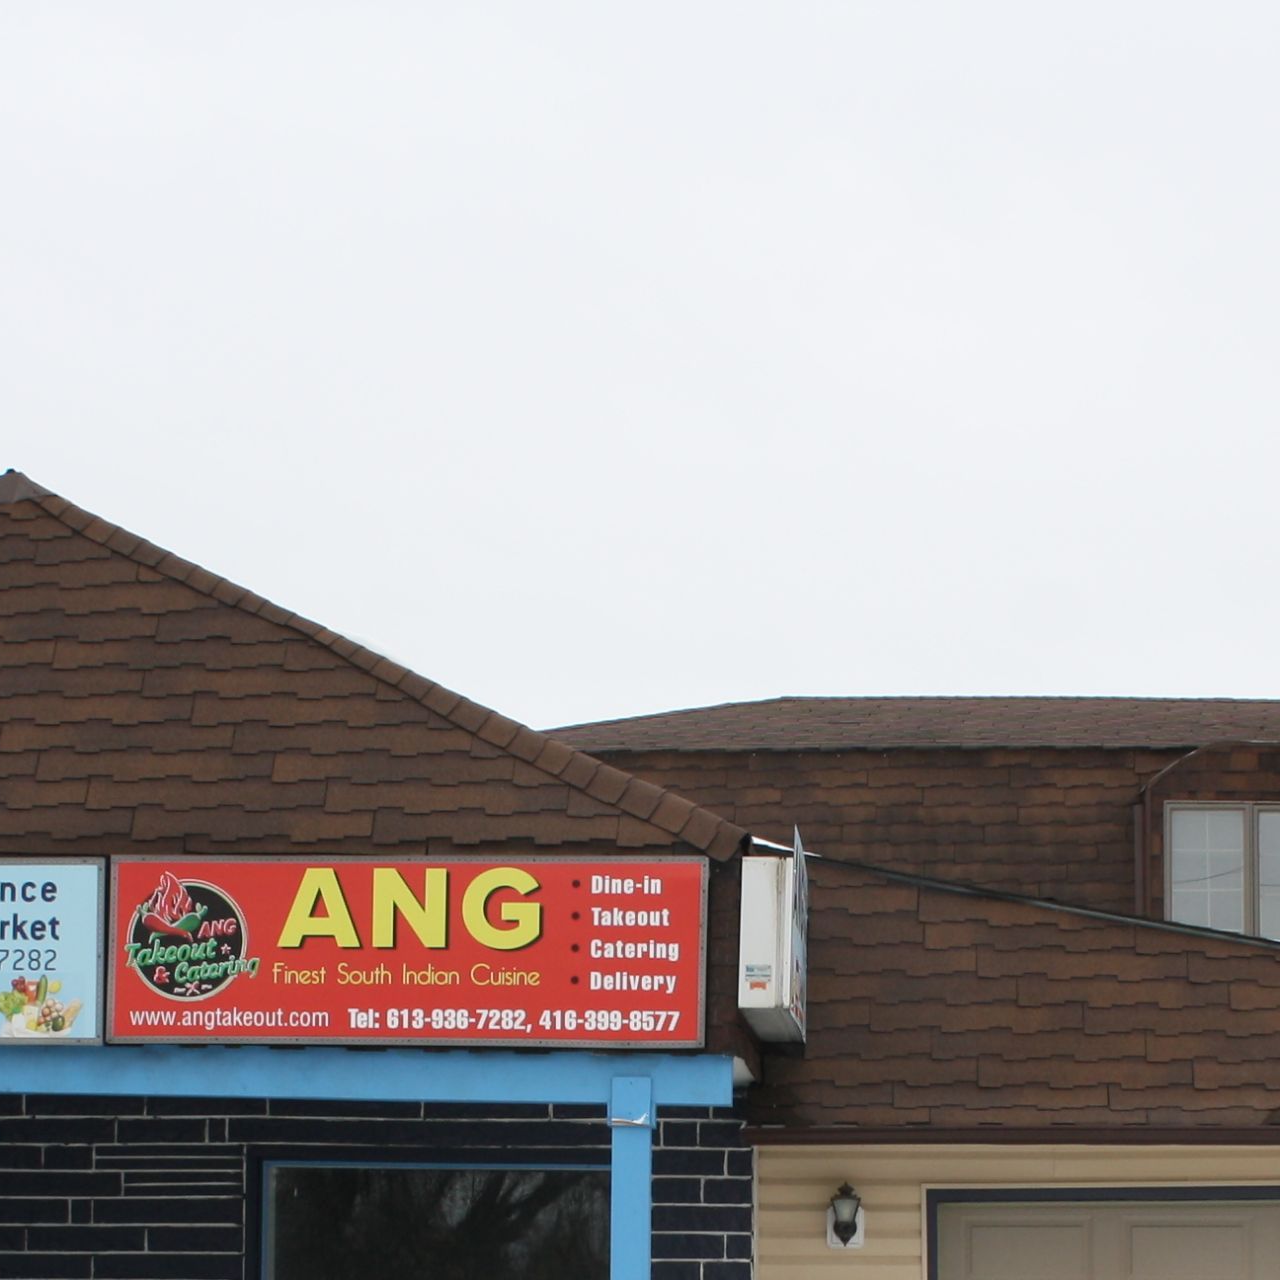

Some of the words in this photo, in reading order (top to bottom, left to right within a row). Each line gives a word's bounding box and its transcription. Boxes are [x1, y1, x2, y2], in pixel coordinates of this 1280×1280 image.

[591, 875, 662, 895] Dine-in
[276, 866, 543, 951] ANG
[591, 907, 670, 927] Takeout
[197, 917, 238, 939] ANG
[124, 937, 218, 967] Takeout
[590, 938, 680, 962] Catering
[174, 954, 261, 983] Catering
[272, 962, 327, 985] Finest
[337, 962, 392, 985] South
[402, 963, 460, 985] Indian
[470, 963, 541, 986] Cuisine
[589, 971, 677, 994] Delivery
[129, 1007, 329, 1031] www.angtakeout.com
[348, 1008, 381, 1030] Tel:
[386, 1008, 533, 1034] 613-936-7282,
[538, 1009, 681, 1032] 416-399-8577
